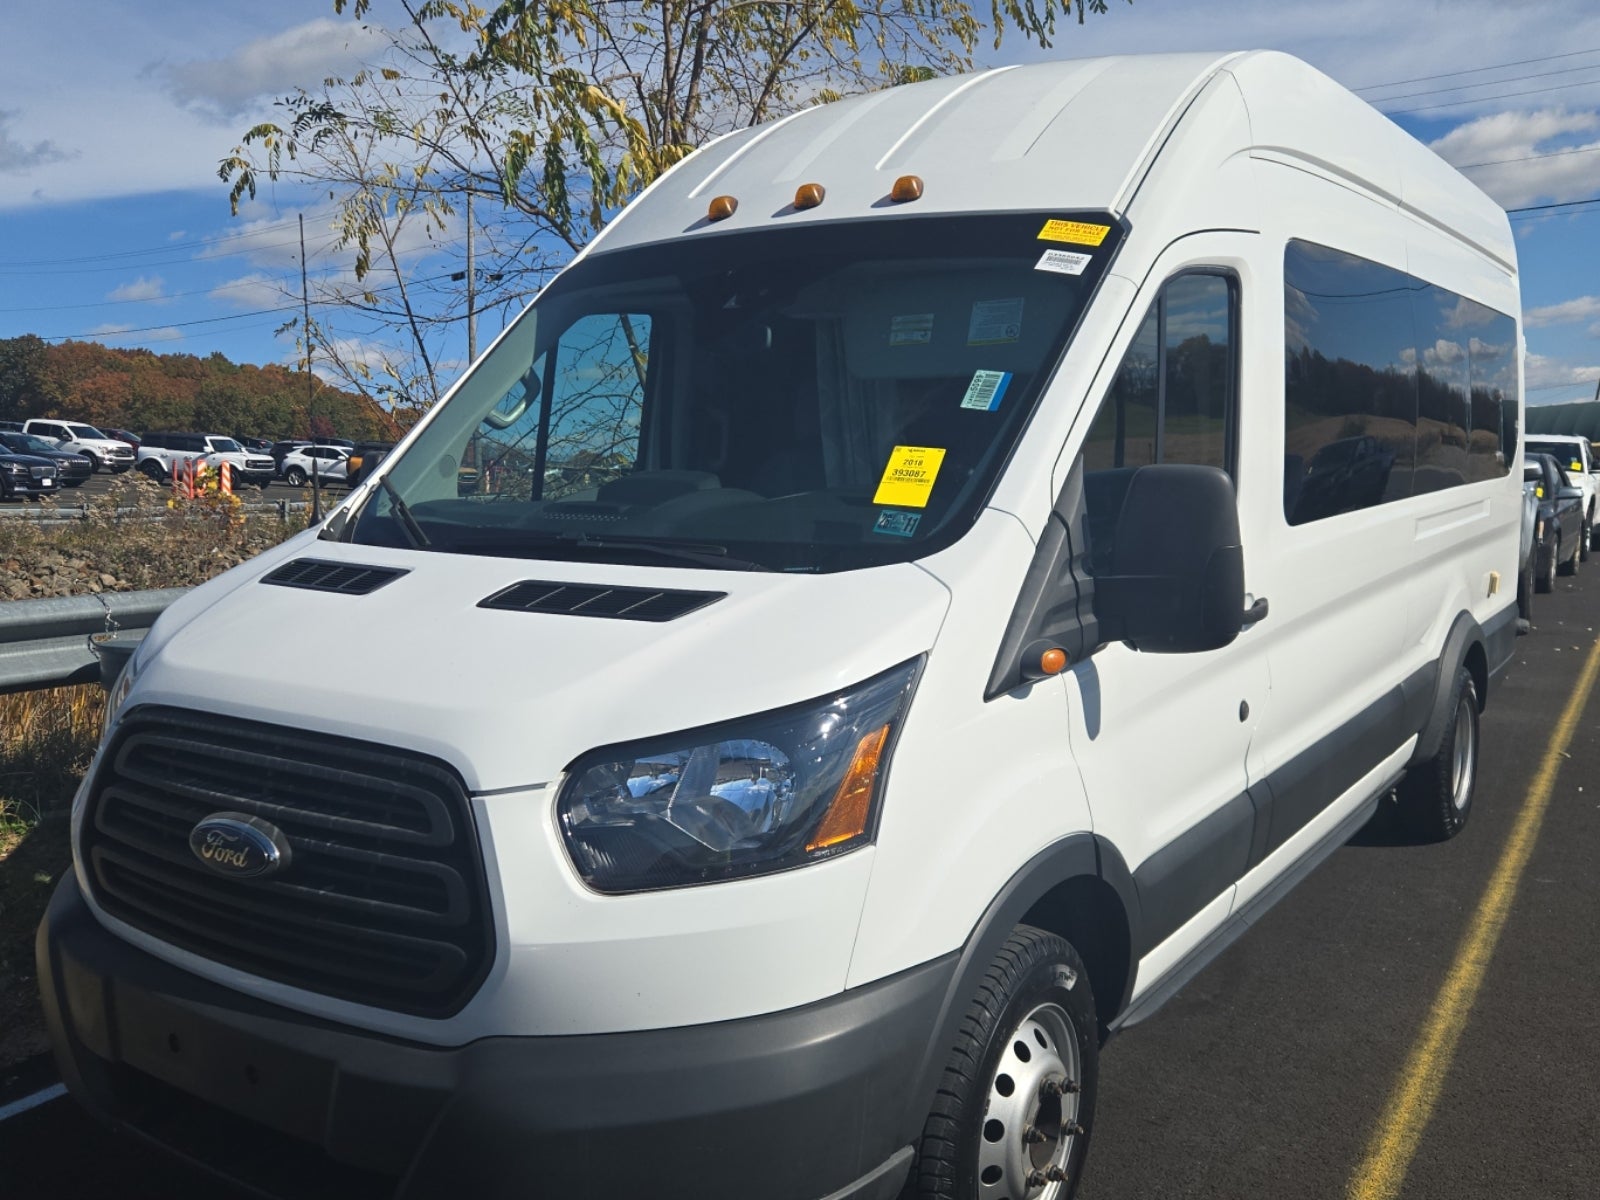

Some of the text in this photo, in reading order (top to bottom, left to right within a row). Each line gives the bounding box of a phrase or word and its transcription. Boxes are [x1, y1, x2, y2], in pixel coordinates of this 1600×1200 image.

[1071, 223, 1104, 231] VEHICLE
[903, 459, 923, 467] 2018
[892, 469, 926, 478] 393087
[202, 830, 249, 867] Ford
